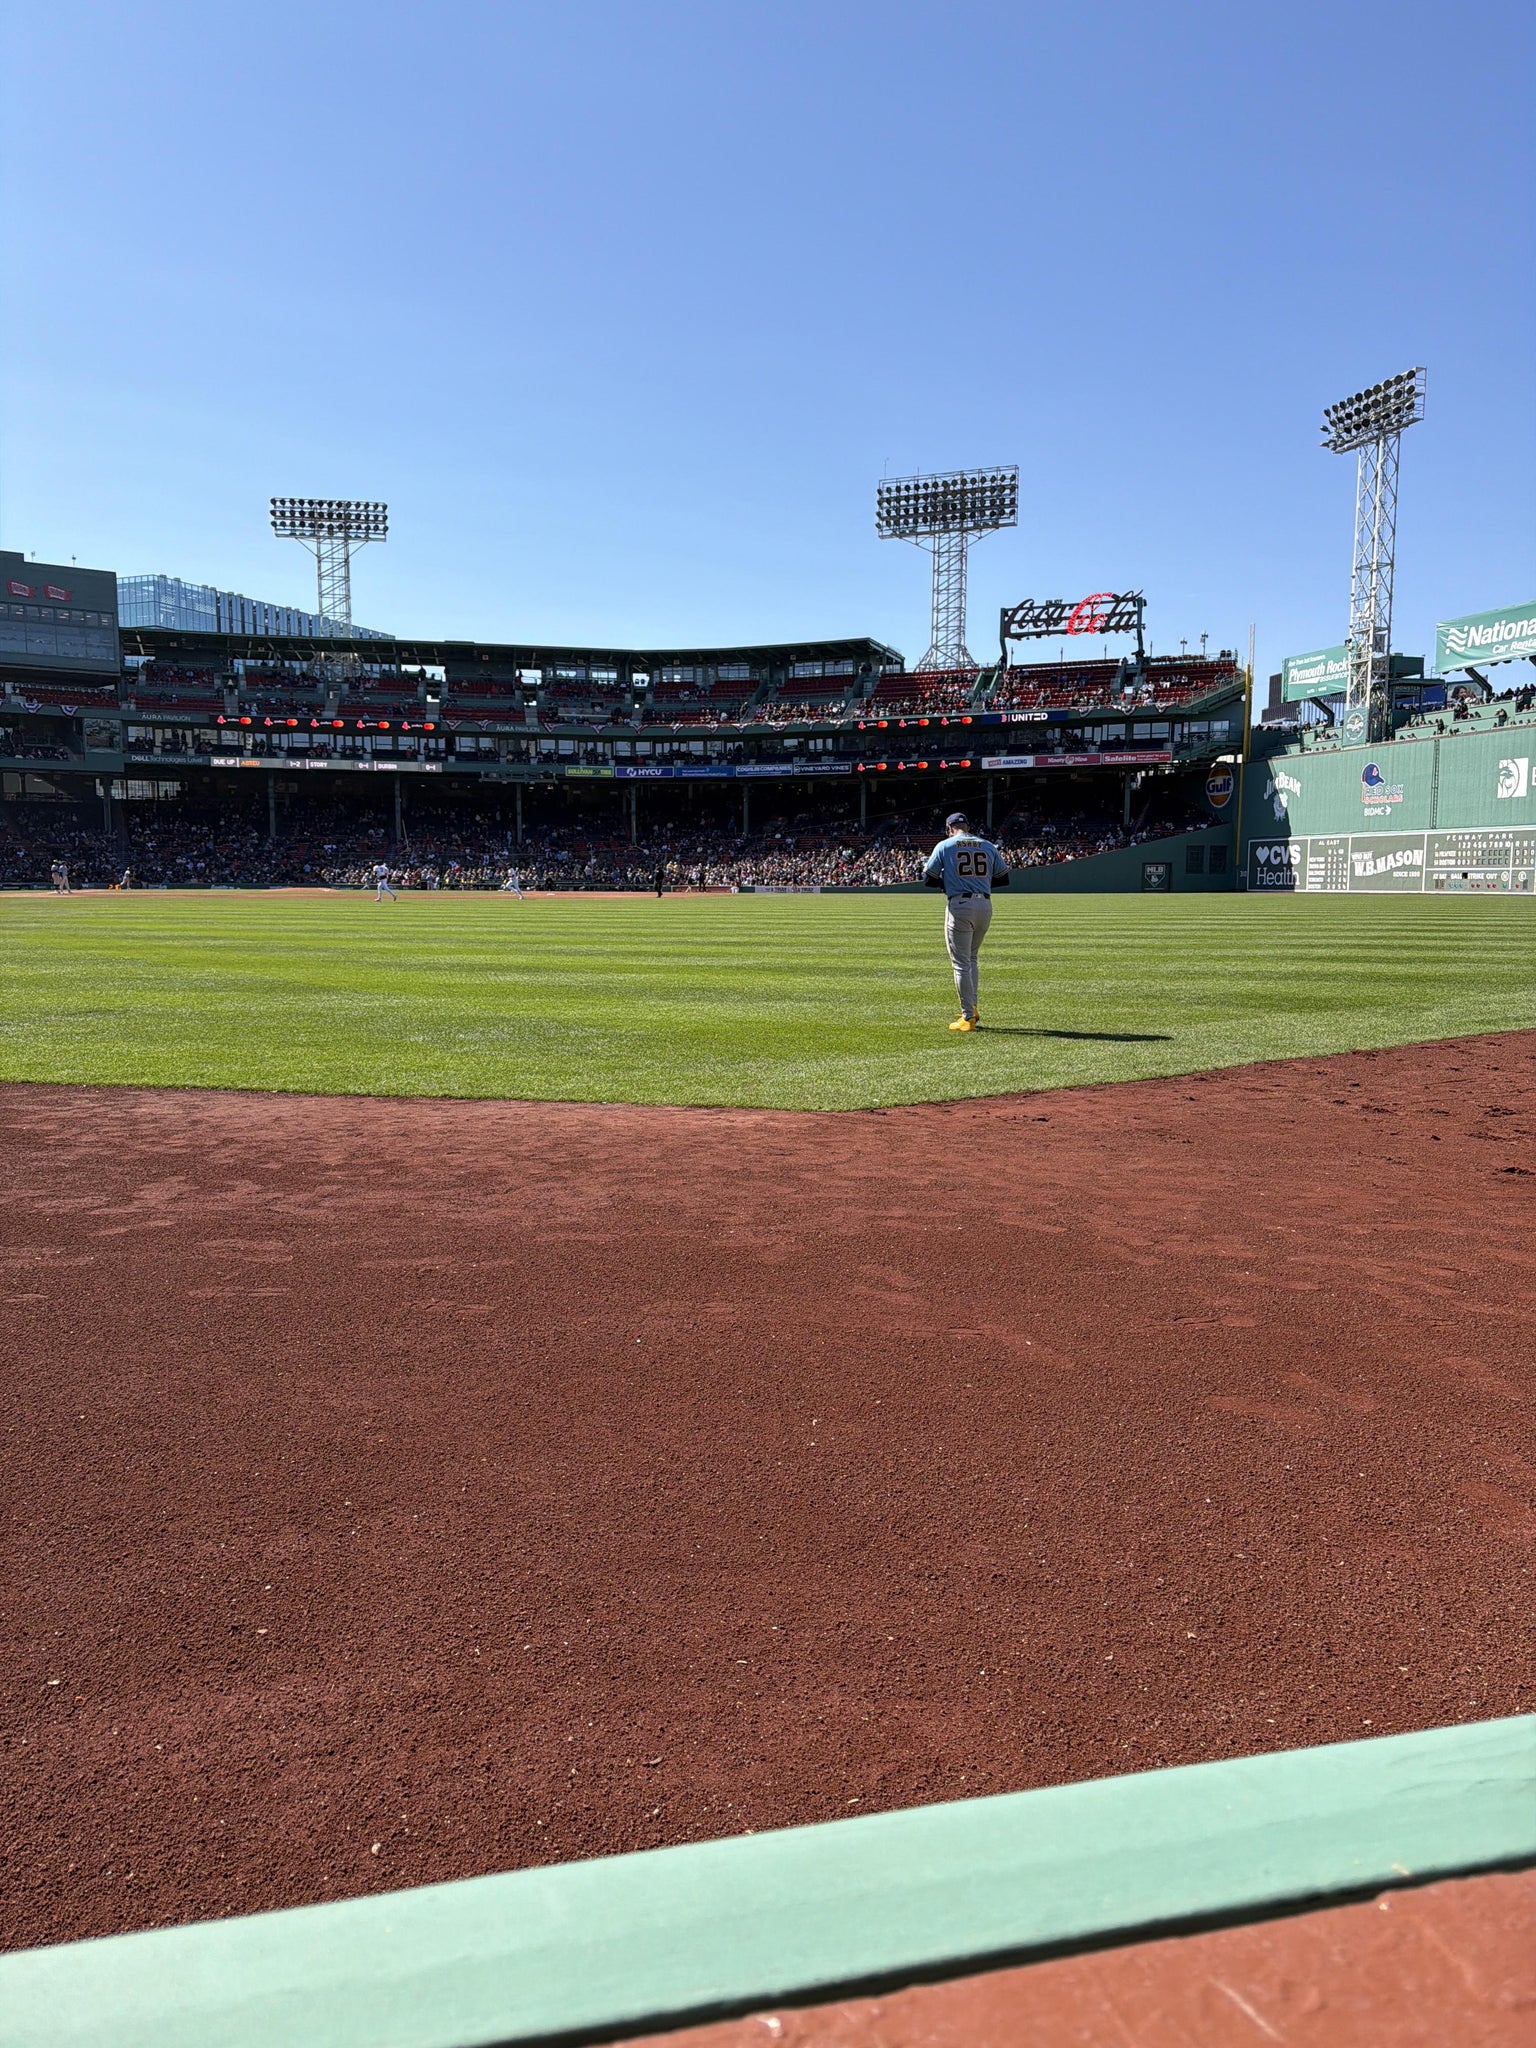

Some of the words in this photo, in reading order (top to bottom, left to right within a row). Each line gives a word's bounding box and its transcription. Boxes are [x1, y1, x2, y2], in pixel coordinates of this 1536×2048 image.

[1003, 590, 1143, 640] Coca-Cola
[1492, 645, 1508, 654] Car
[1289, 662, 1325, 683] Plymouth
[1326, 657, 1348, 674] Rock
[1011, 712, 1048, 722] UNITED
[639, 768, 662, 776] HYCU
[1206, 777, 1232, 793] Gulf
[1278, 771, 1301, 797] BEAM
[1365, 786, 1384, 795] RED
[1385, 784, 1404, 794] SOX
[1446, 833, 1482, 841] FENWAY
[1270, 844, 1301, 865] CVS
[957, 850, 988, 878] 26
[1147, 866, 1164, 874] MLB
[1256, 867, 1300, 886] Health
[1467, 872, 1485, 880] STRIKE
[1486, 872, 1498, 880] OUT
